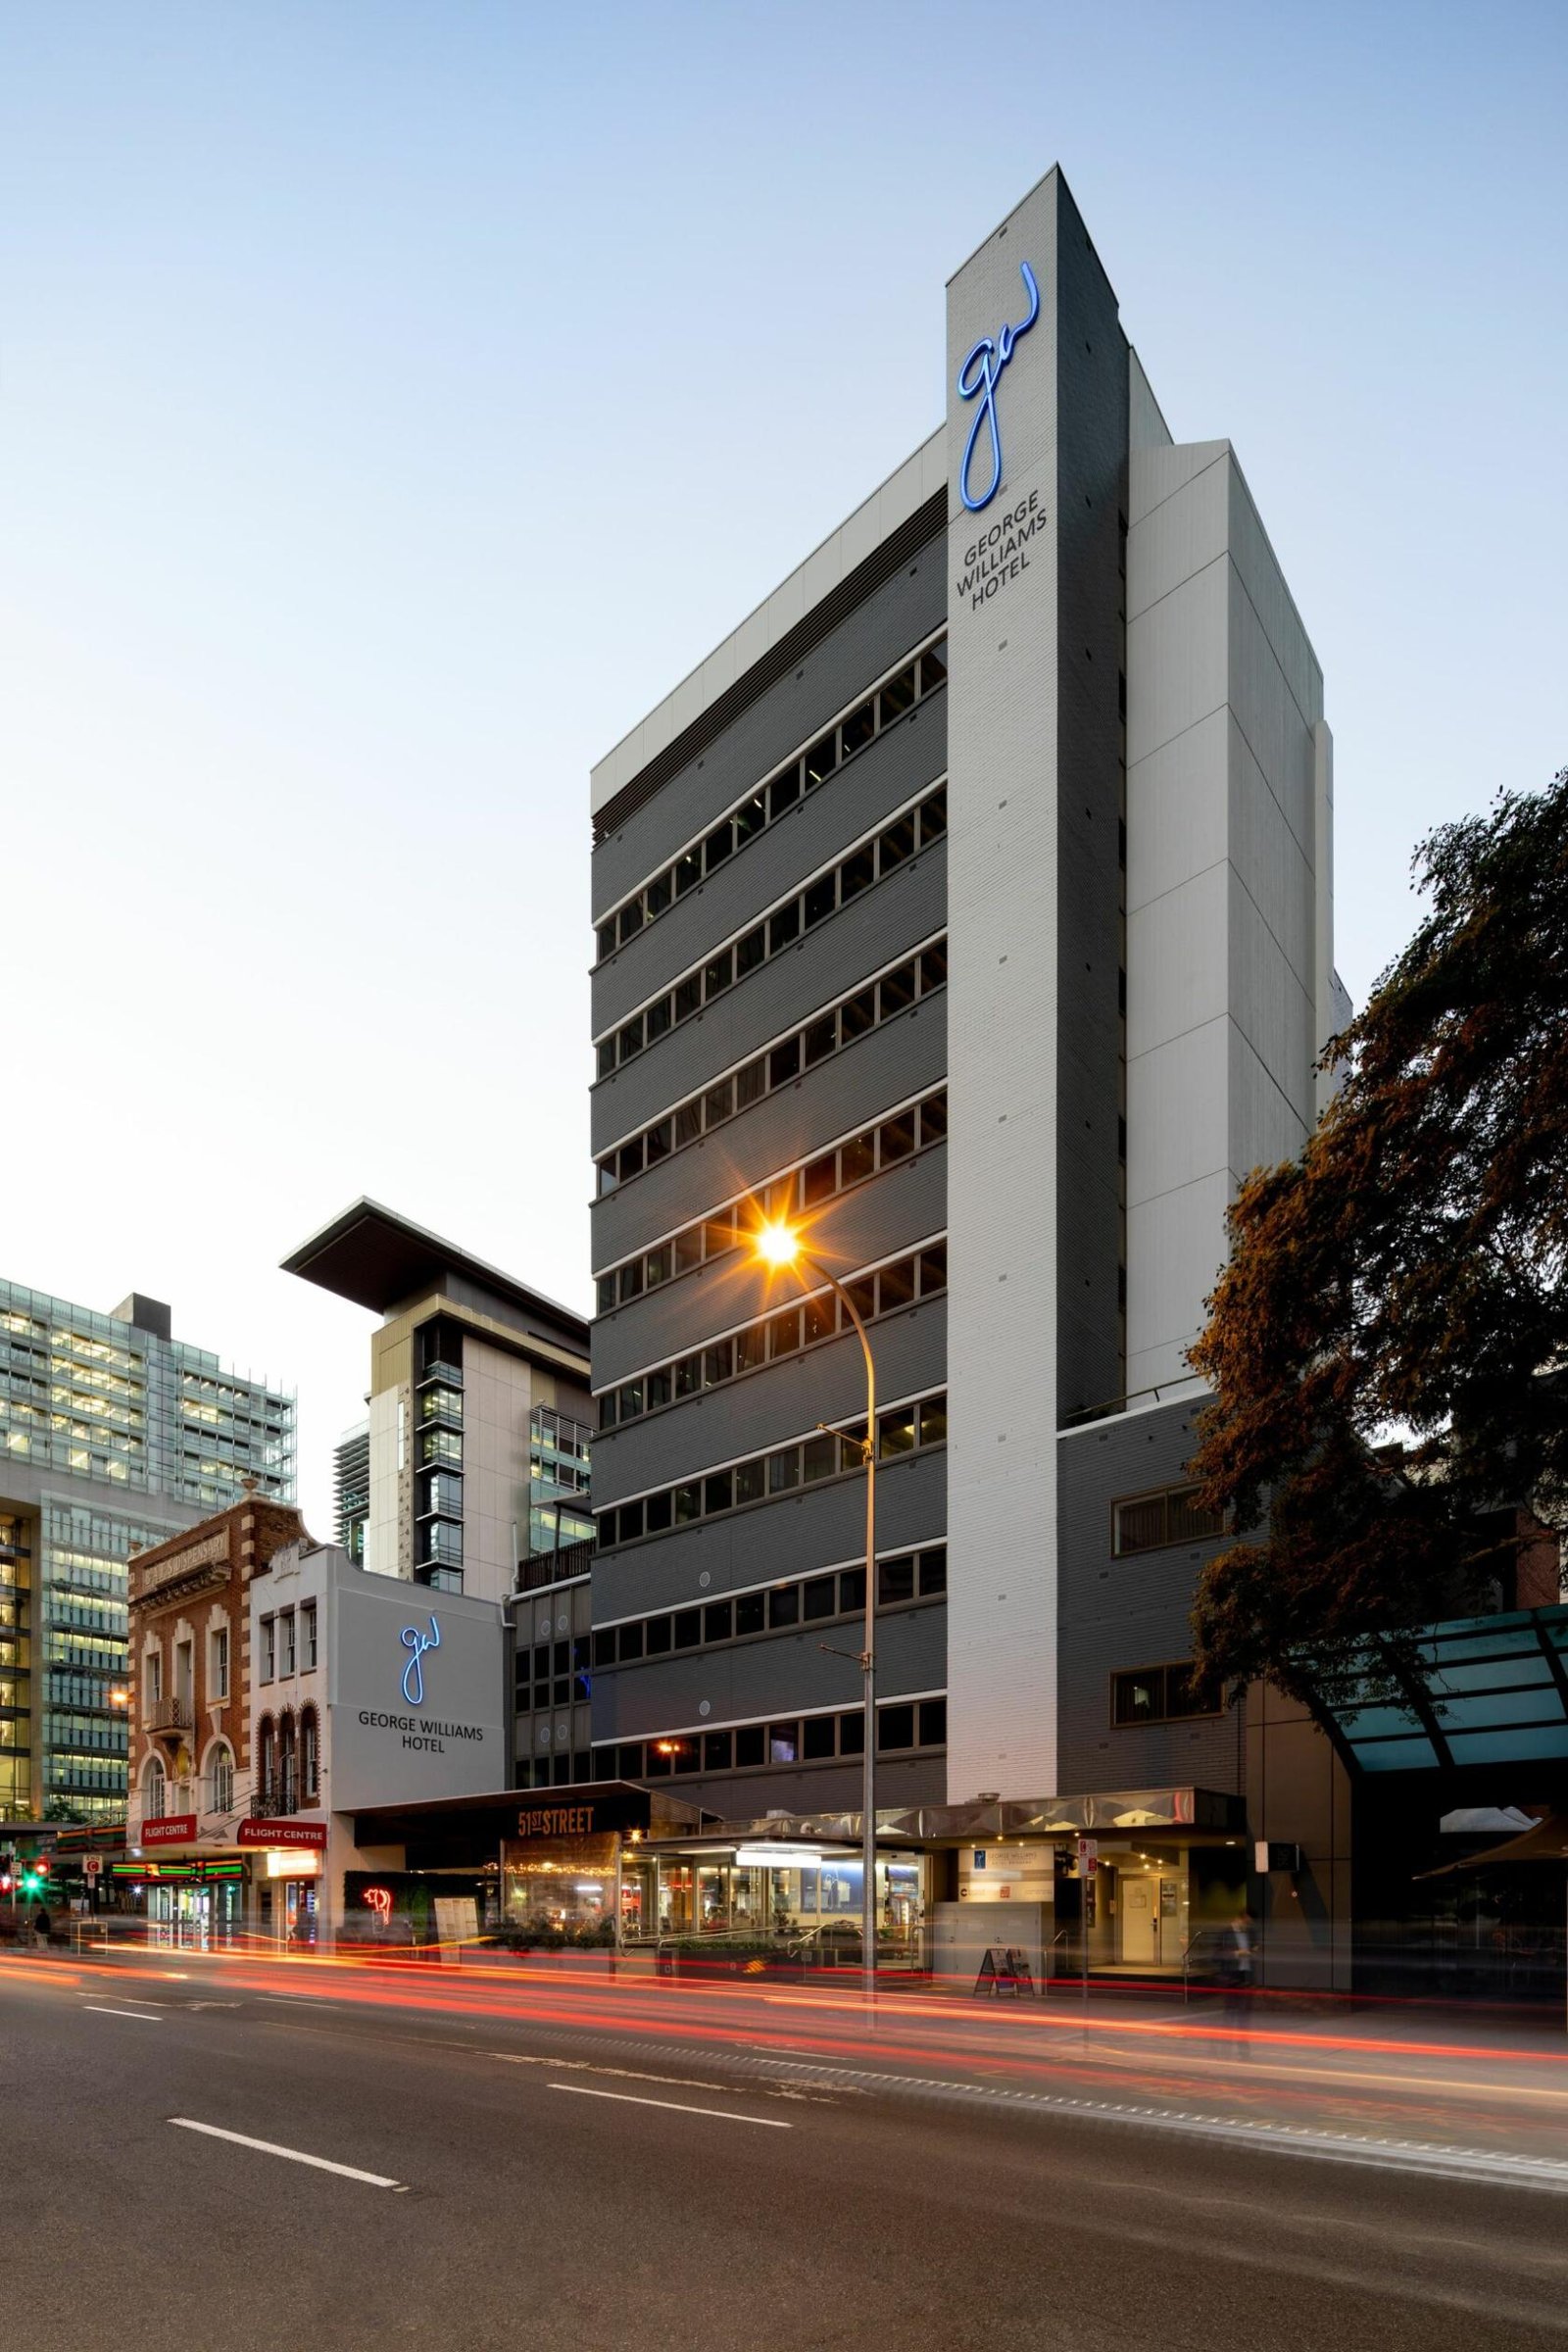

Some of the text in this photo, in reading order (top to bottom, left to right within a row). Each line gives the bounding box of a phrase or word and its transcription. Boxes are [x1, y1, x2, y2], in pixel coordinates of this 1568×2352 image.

[964, 489, 1039, 566] GEORGE
[956, 508, 1048, 597] WILLIAMS
[972, 552, 1031, 612] HOTEL
[358, 1711, 484, 1741] GEORGE WILLIAMS
[402, 1736, 445, 1753] HOTEL
[145, 1824, 188, 1838] FLIGHT CENTRE
[245, 1828, 323, 1840] FLIGHT CENTRE
[542, 1806, 594, 1835] STREET
